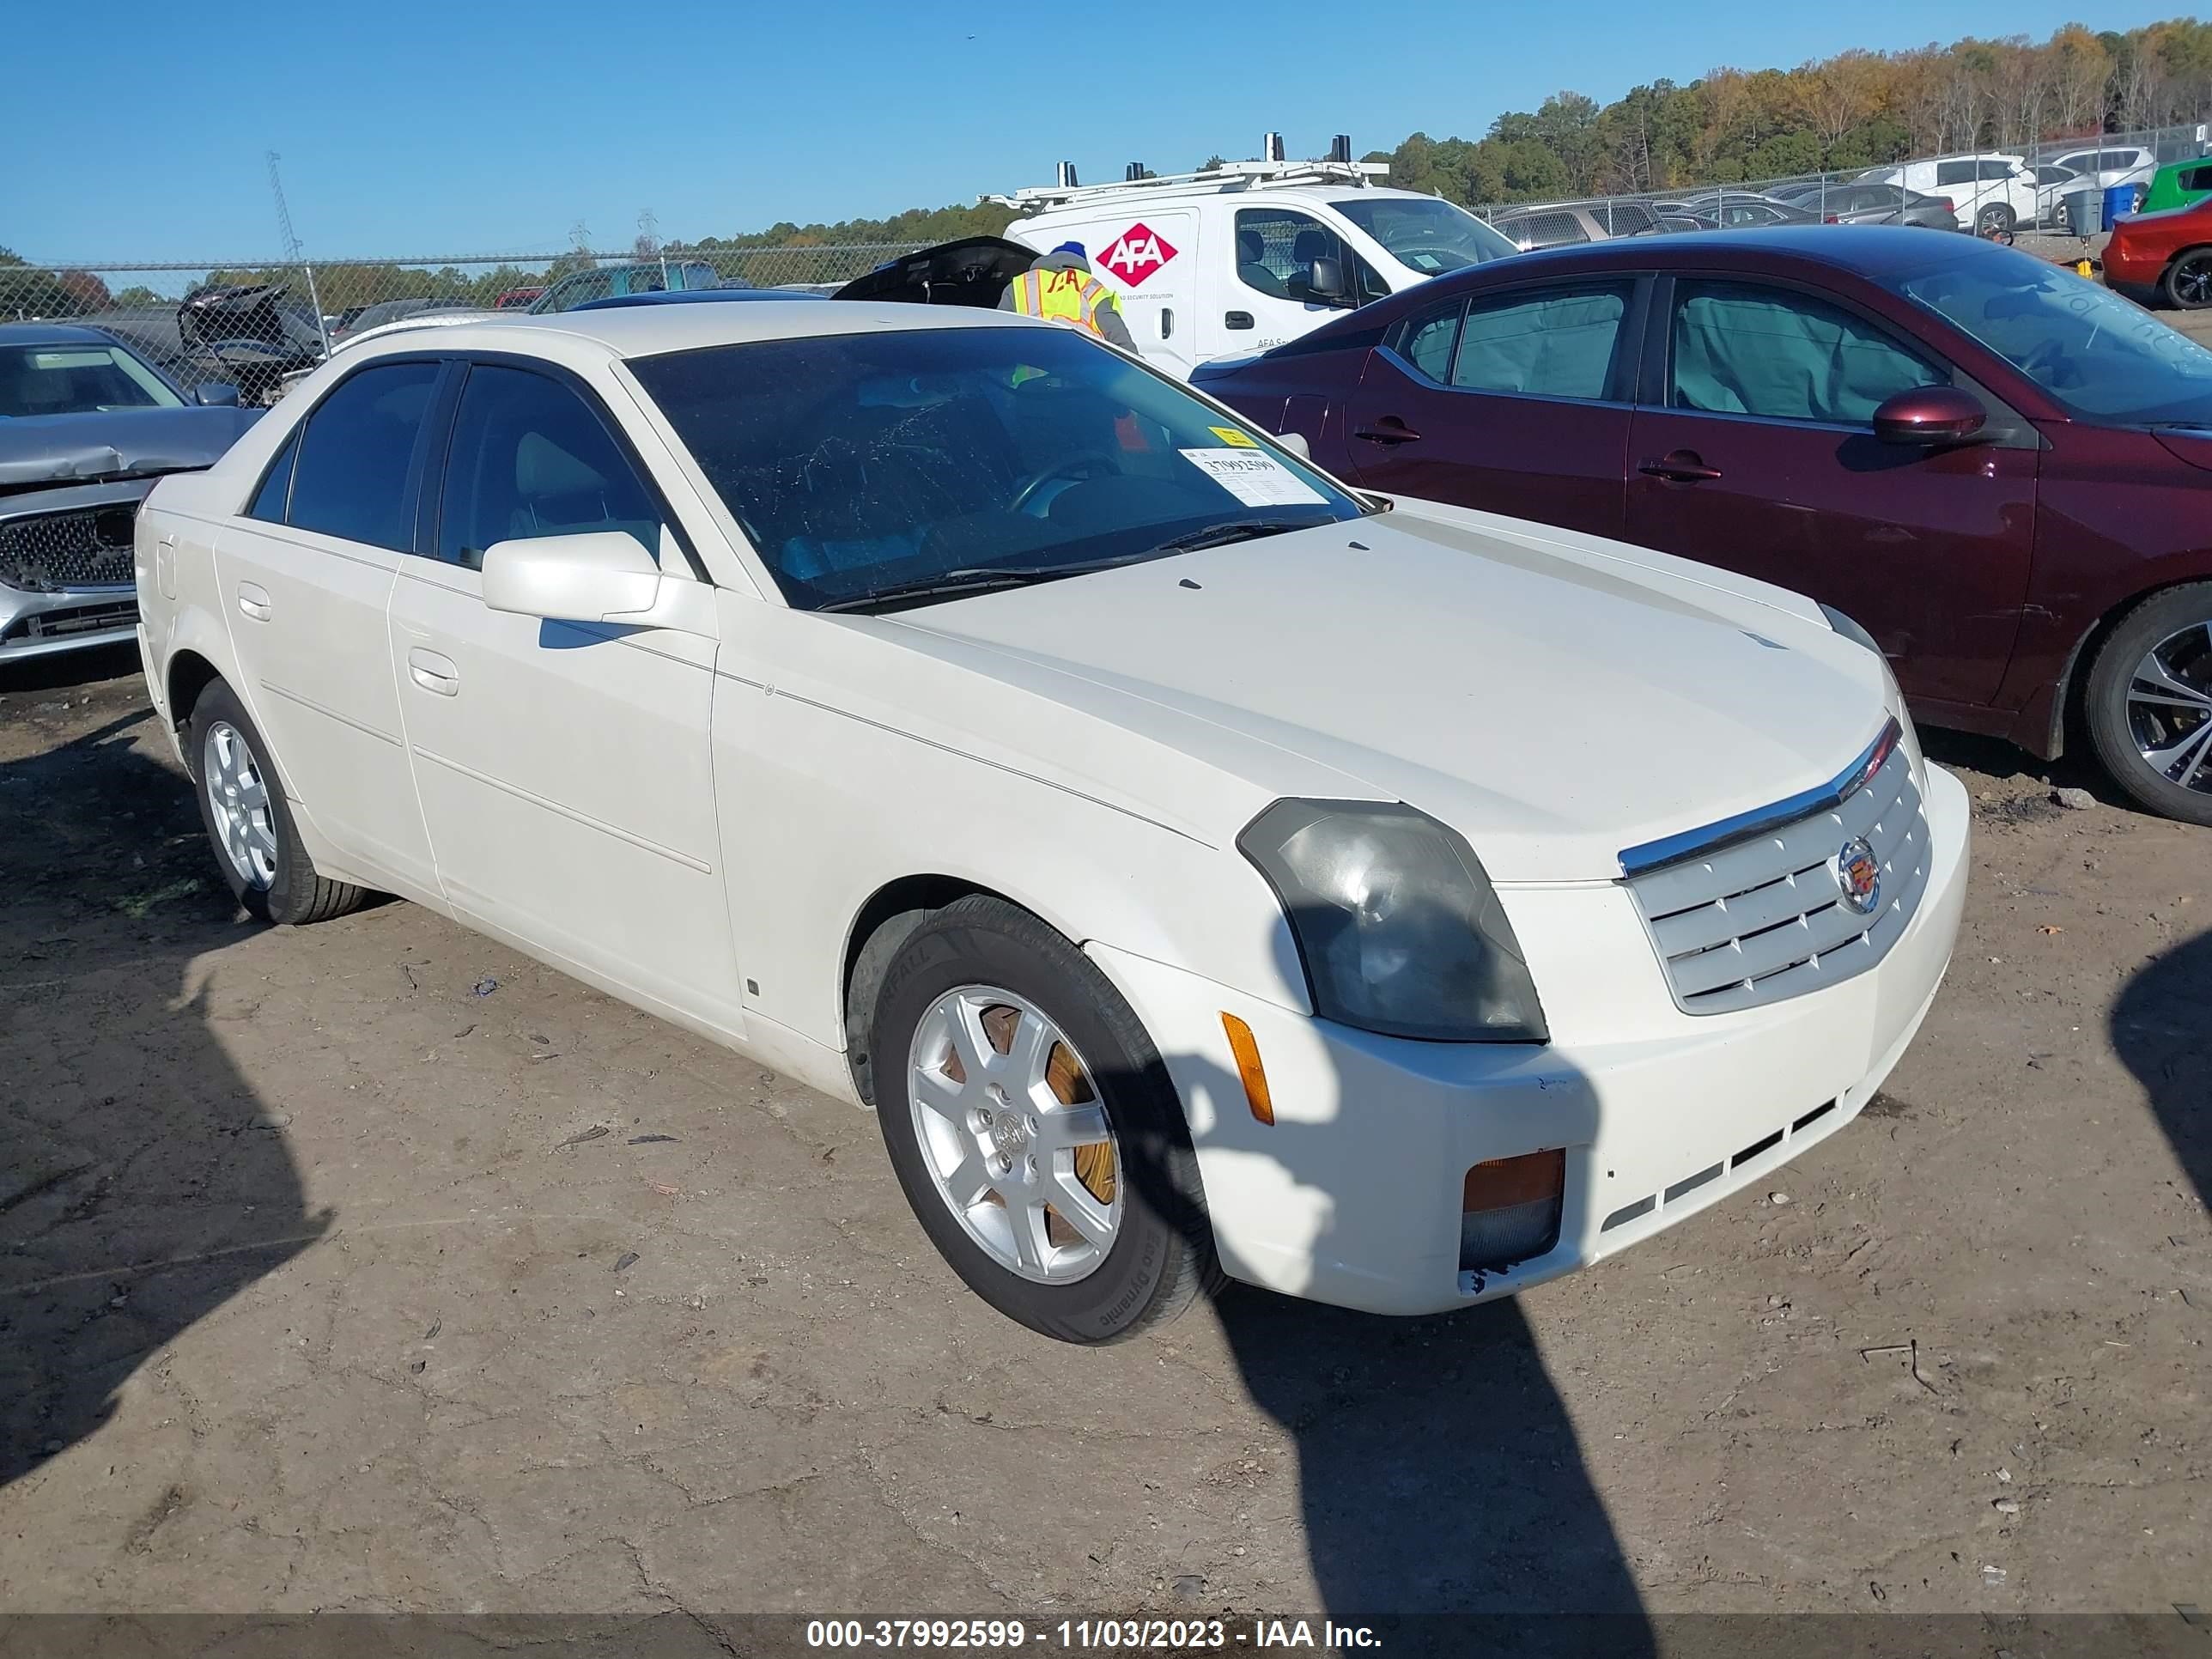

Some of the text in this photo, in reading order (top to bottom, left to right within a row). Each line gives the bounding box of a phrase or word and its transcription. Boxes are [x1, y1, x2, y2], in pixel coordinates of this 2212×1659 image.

[1106, 234, 1166, 274] AFA
[1203, 460, 1276, 472] 37992599
[1098, 1269, 1151, 1327] Dynamic
